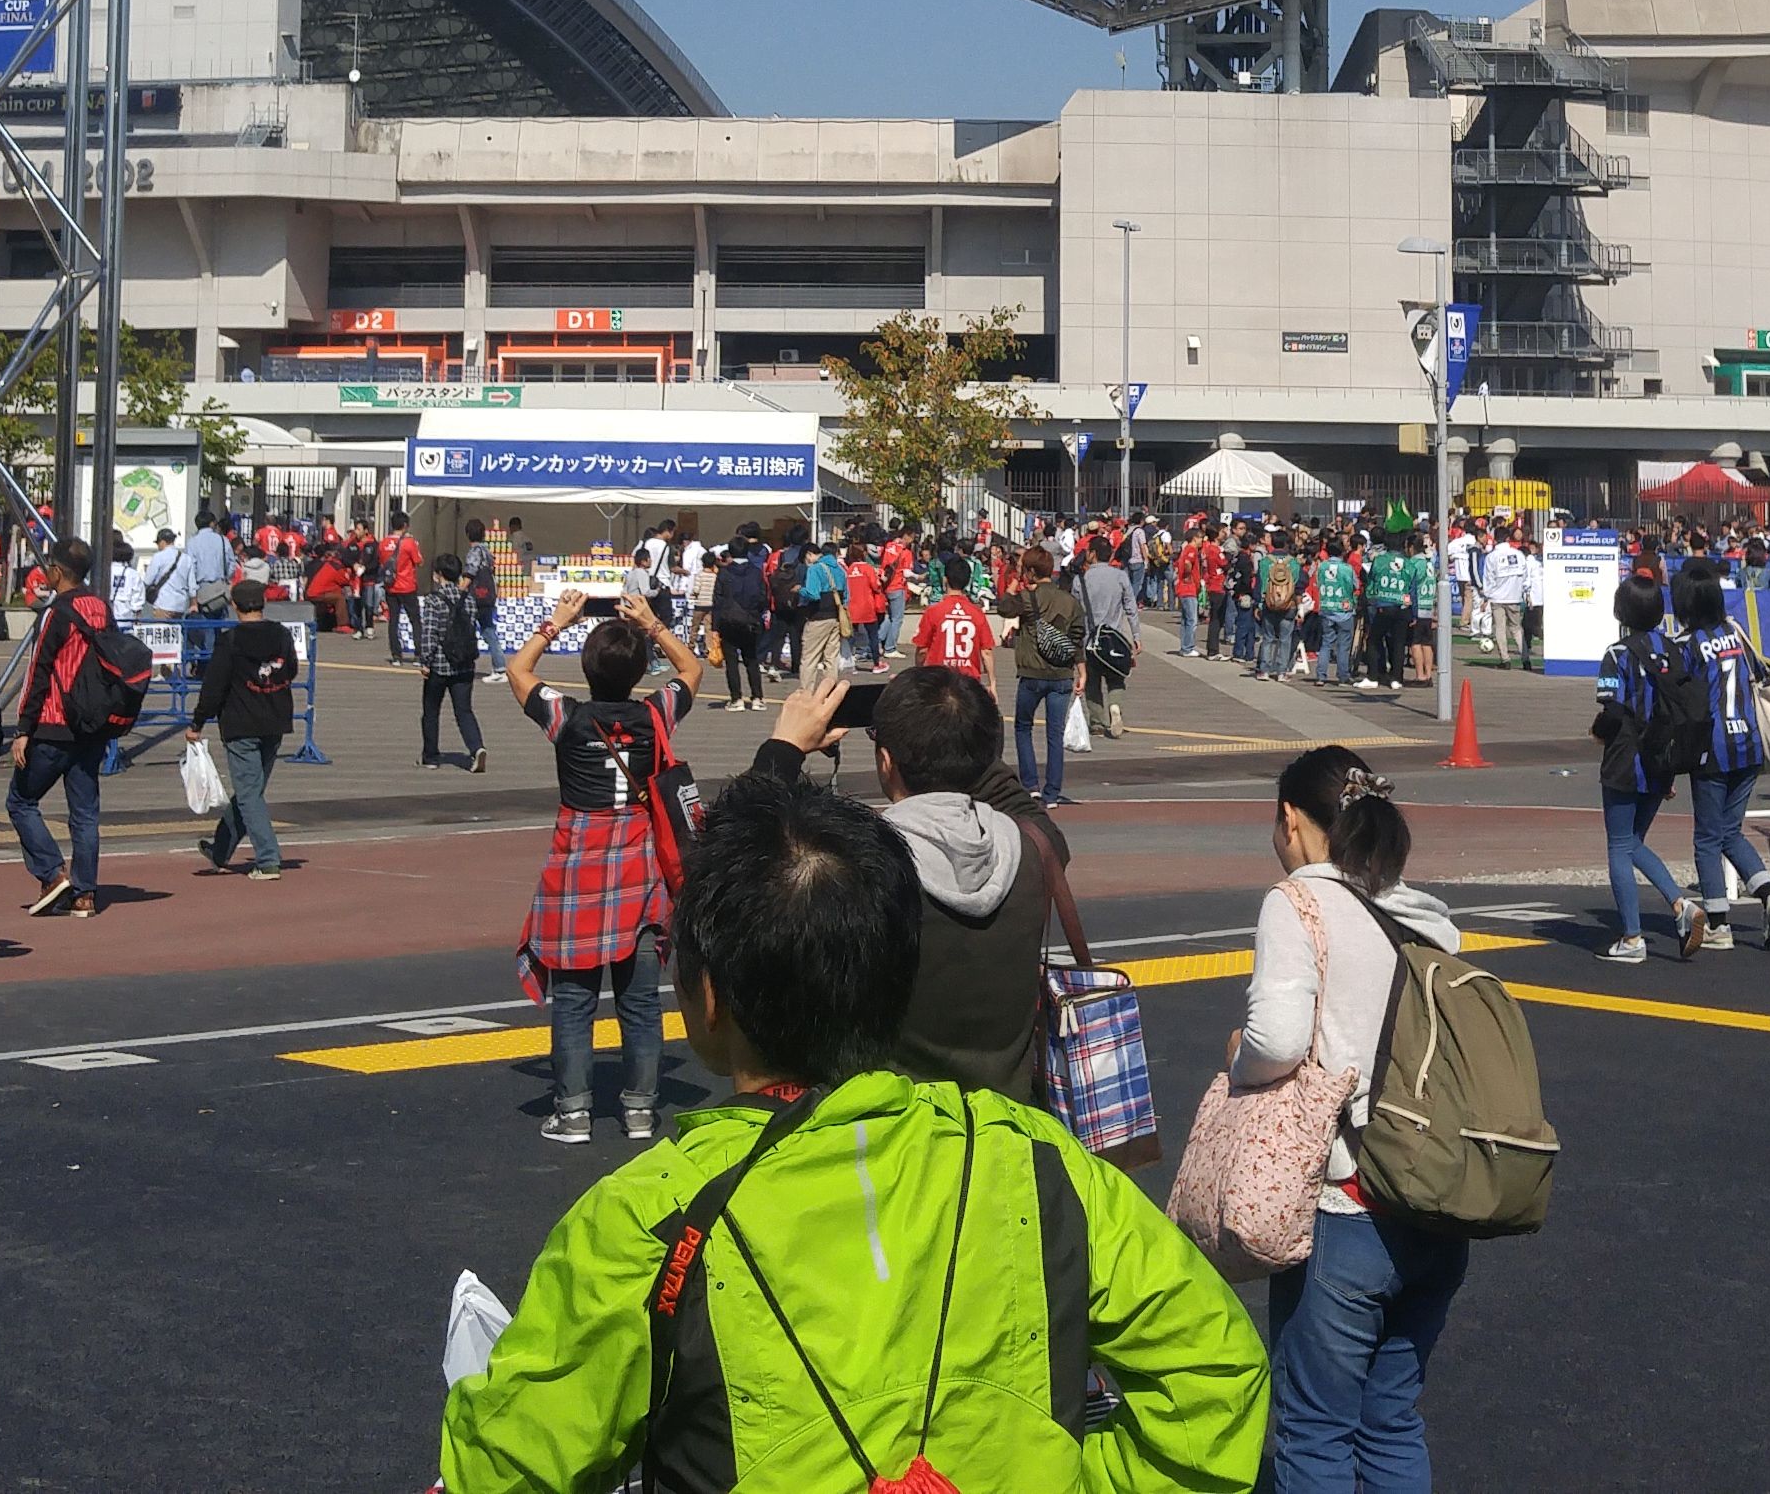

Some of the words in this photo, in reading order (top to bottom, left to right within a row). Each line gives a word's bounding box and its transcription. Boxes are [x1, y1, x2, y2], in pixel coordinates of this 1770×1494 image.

[5, 0, 30, 12] CUP
[0, 12, 35, 24] FINAL
[355, 312, 383, 329] D2
[568, 311, 595, 329] D1
[386, 386, 475, 399] バックスタンド
[940, 619, 977, 659] 13
[1721, 658, 1737, 719] 7
[656, 1225, 703, 1317] PENTAX
